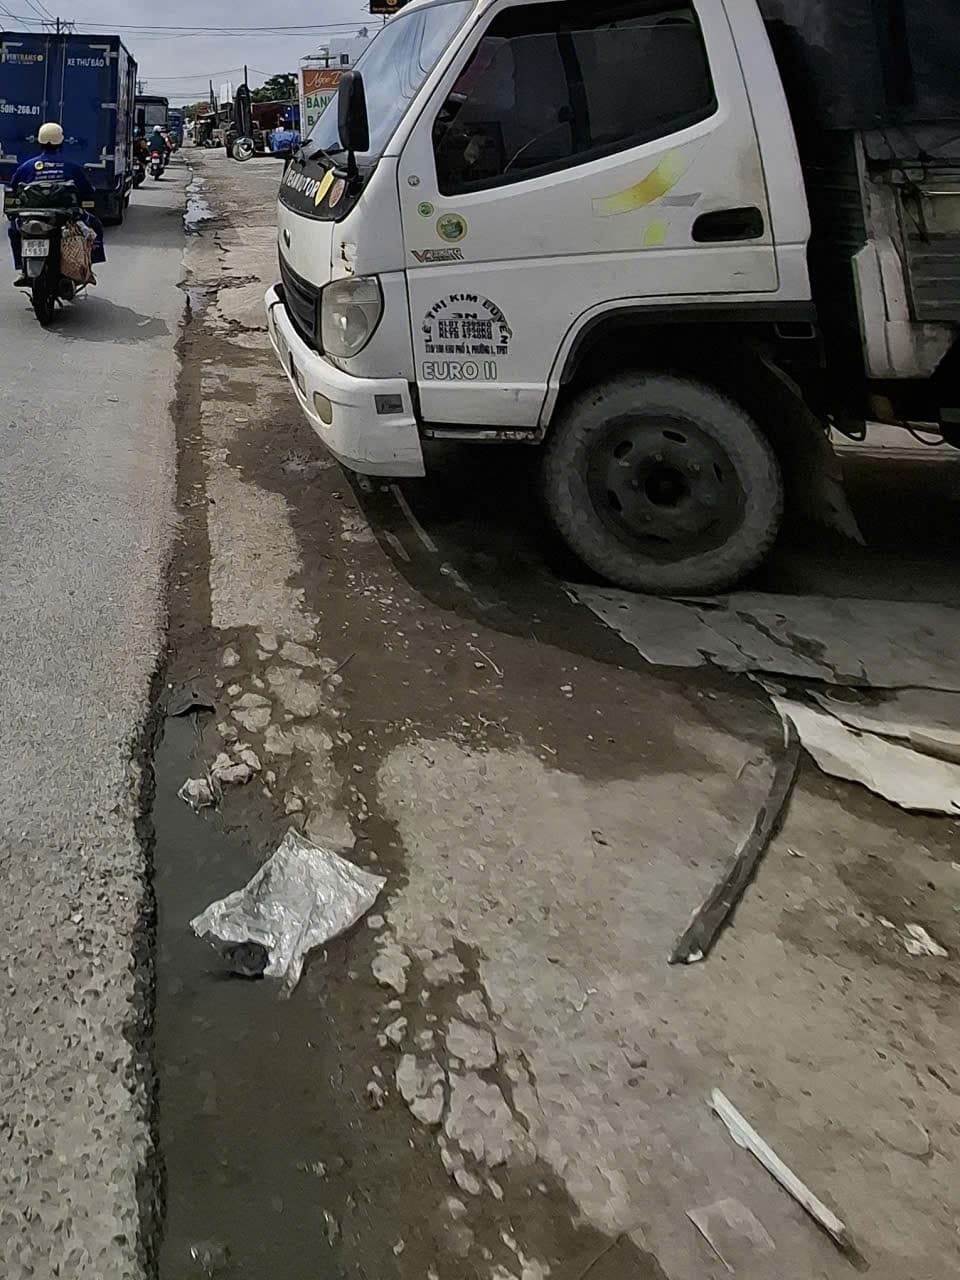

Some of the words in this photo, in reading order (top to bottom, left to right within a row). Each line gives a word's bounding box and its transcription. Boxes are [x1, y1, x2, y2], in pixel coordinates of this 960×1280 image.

[67, 58, 76, 66] XE
[77, 57, 91, 67] THƯ
[91, 56, 105, 68] BÁO
[449, 293, 478, 303] KIM
[422, 361, 479, 380] EURO
